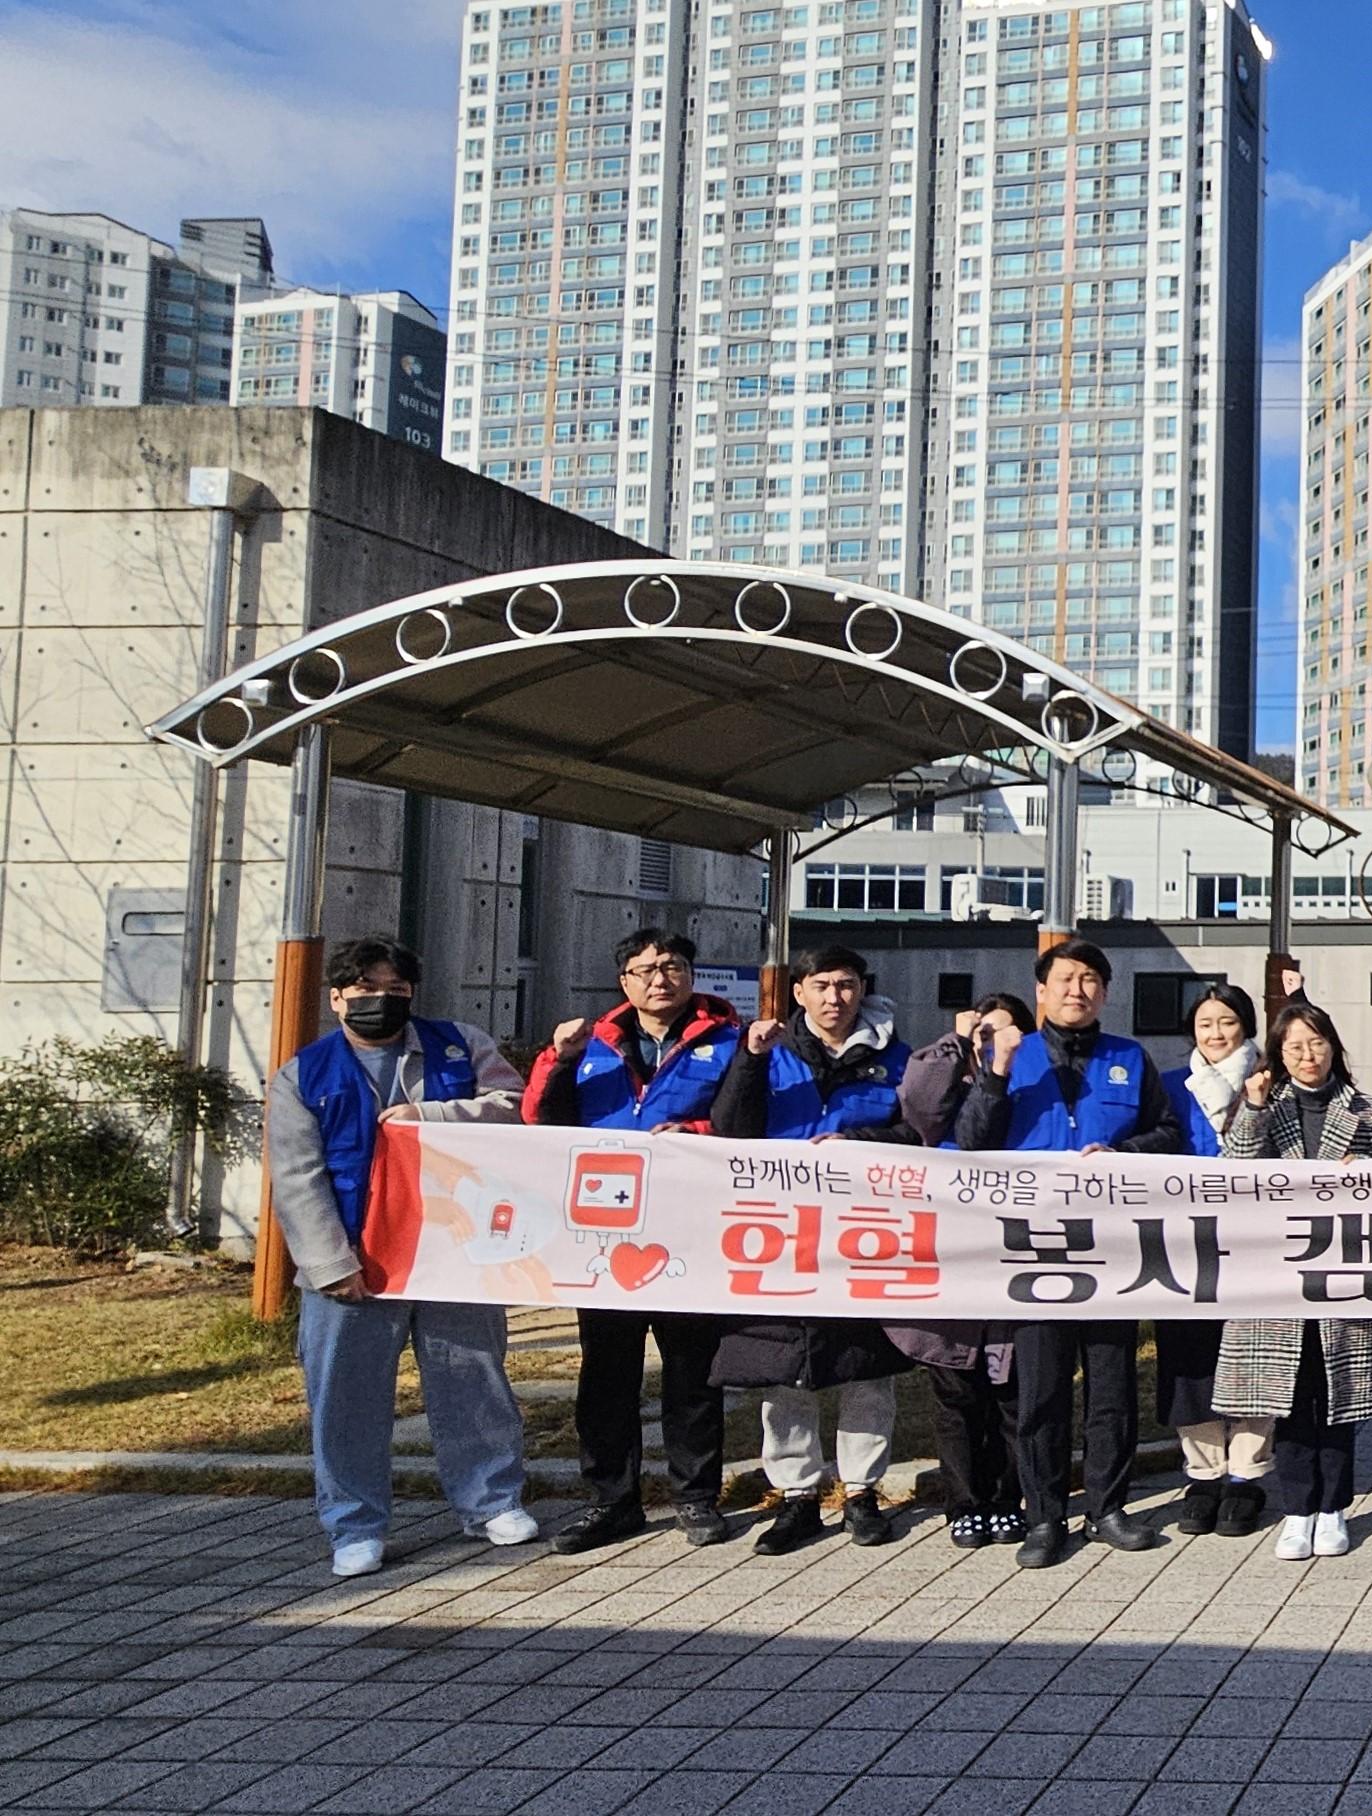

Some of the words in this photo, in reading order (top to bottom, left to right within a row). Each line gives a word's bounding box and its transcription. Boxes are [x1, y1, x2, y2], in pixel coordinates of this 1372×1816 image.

[405, 426, 431, 449] 103
[728, 1155, 853, 1196] 함께하는
[866, 1163, 932, 1202] 헌혈,
[949, 1166, 1039, 1205] 생명을
[1053, 1172, 1148, 1205] 구하는
[1164, 1172, 1294, 1202] 아름다운
[721, 1200, 941, 1301] 헌혈
[995, 1215, 1230, 1304] 봉사
